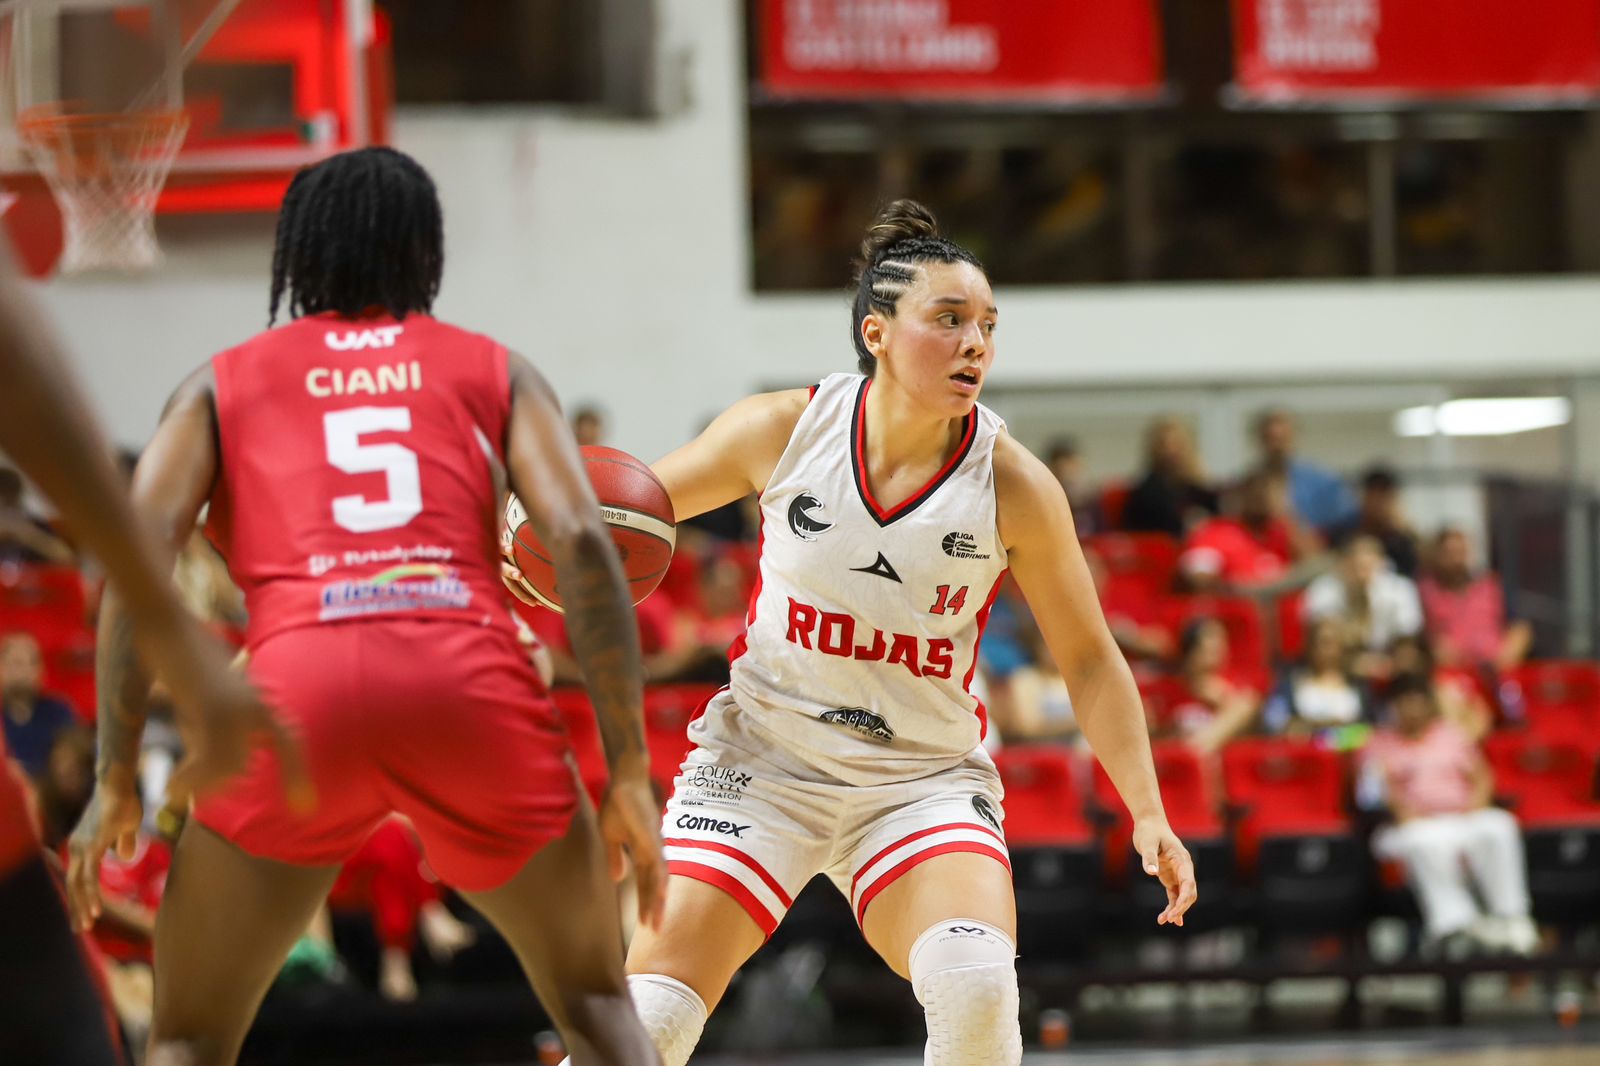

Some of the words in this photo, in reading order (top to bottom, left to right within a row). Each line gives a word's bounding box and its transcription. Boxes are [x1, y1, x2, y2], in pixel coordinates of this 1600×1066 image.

[324, 326, 404, 350] UAT
[305, 360, 423, 397] CIANI
[323, 406, 424, 533] 5
[957, 532, 974, 541] LIGA
[929, 585, 969, 615] 14
[785, 596, 955, 680] ROJAS
[695, 790, 742, 801] SHERATON
